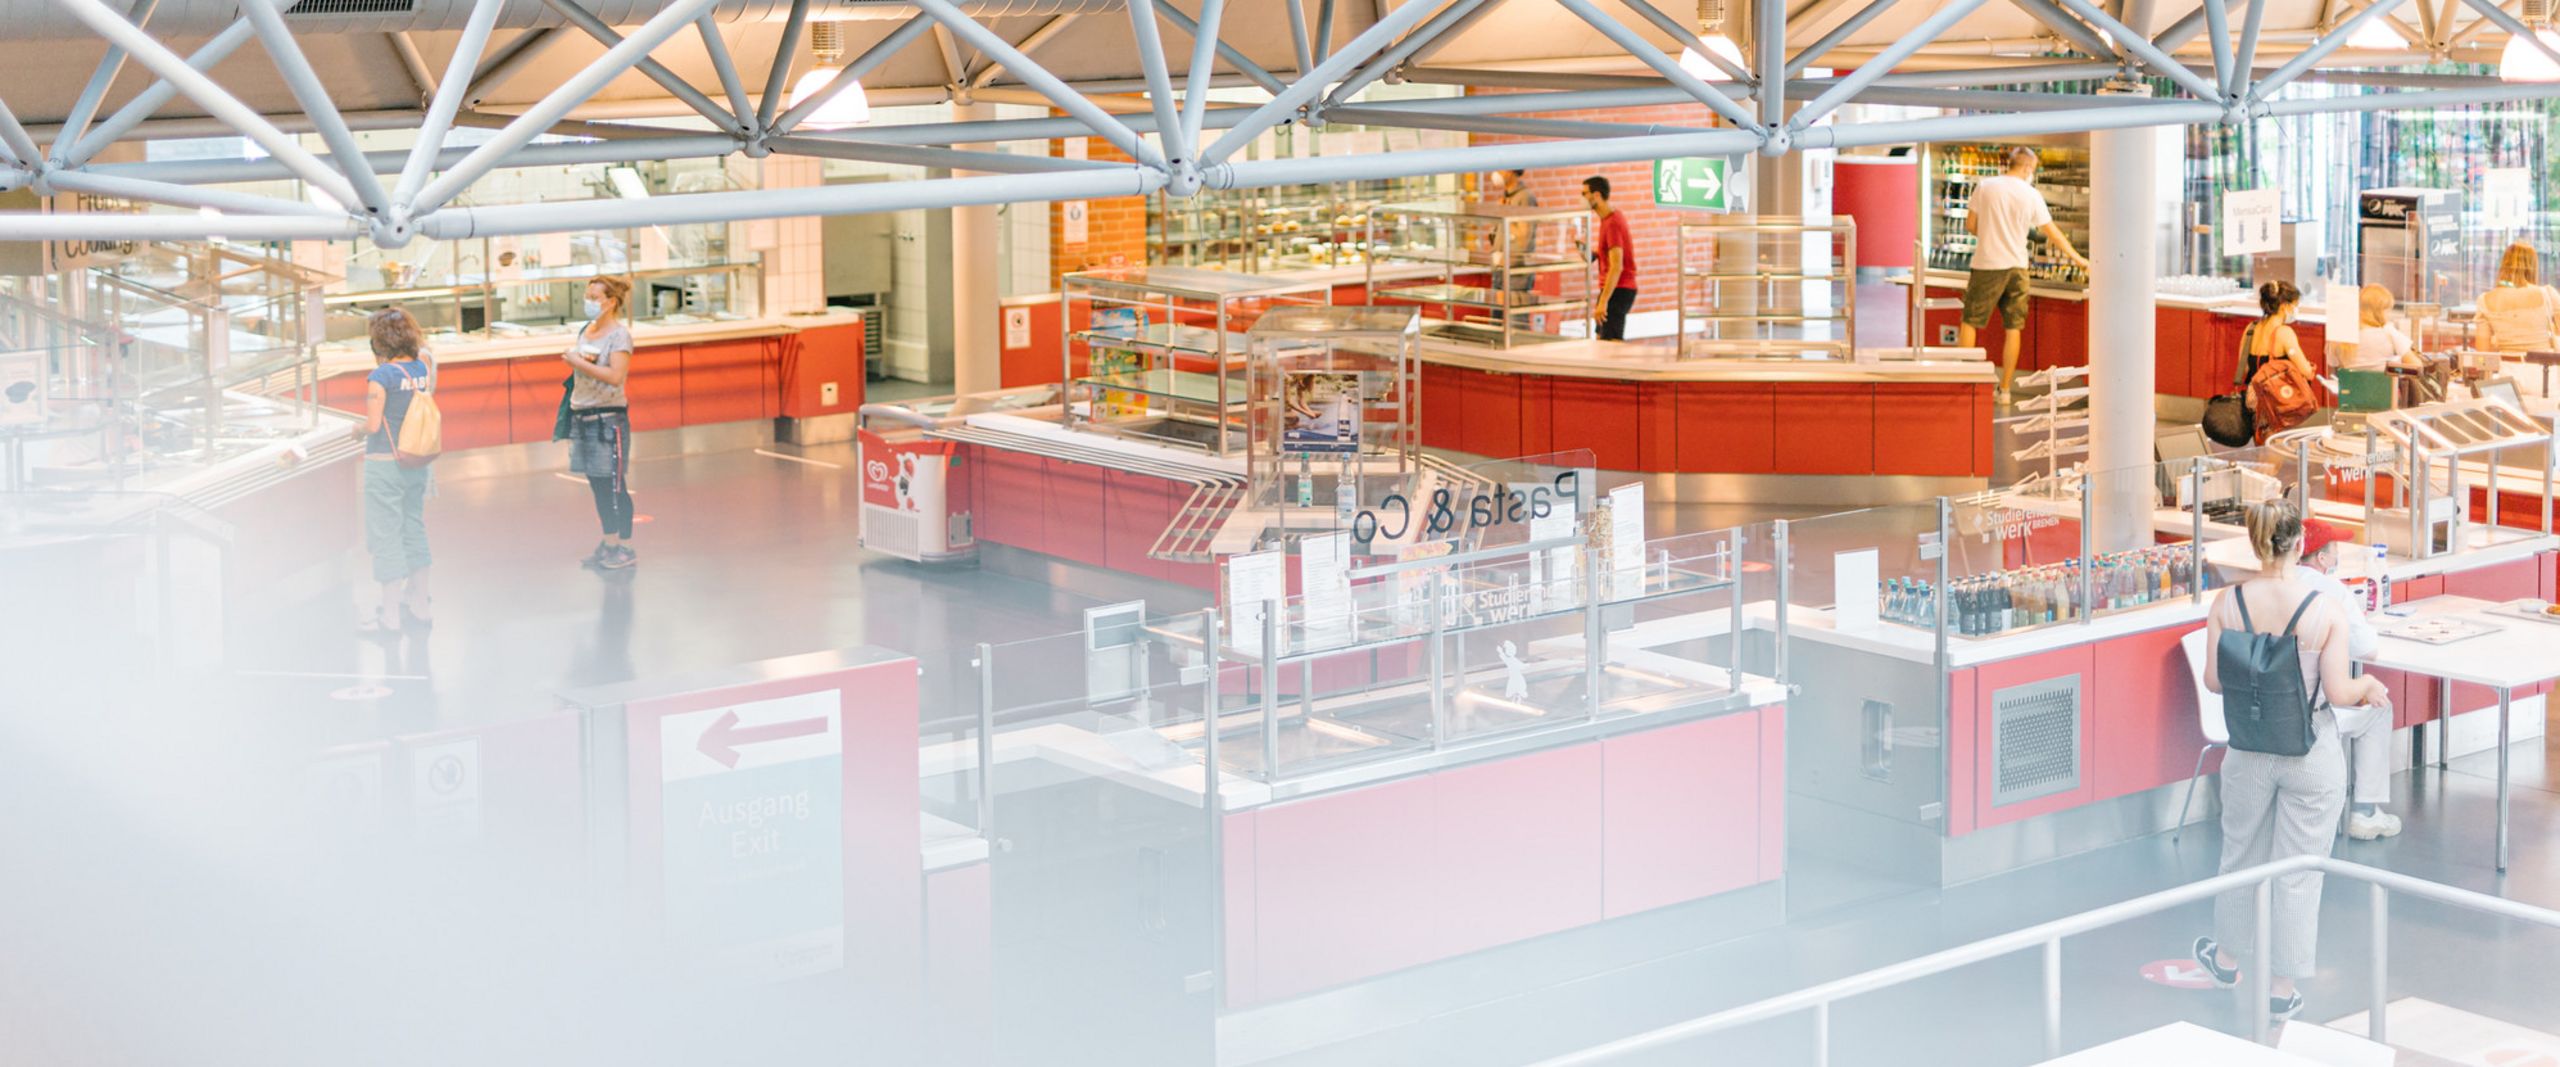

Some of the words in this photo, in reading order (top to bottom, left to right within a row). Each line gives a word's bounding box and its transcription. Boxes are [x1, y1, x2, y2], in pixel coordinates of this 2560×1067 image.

[1995, 520, 2032, 541] werk
[699, 790, 810, 829] Ausgang
[732, 828, 781, 859] Exit
